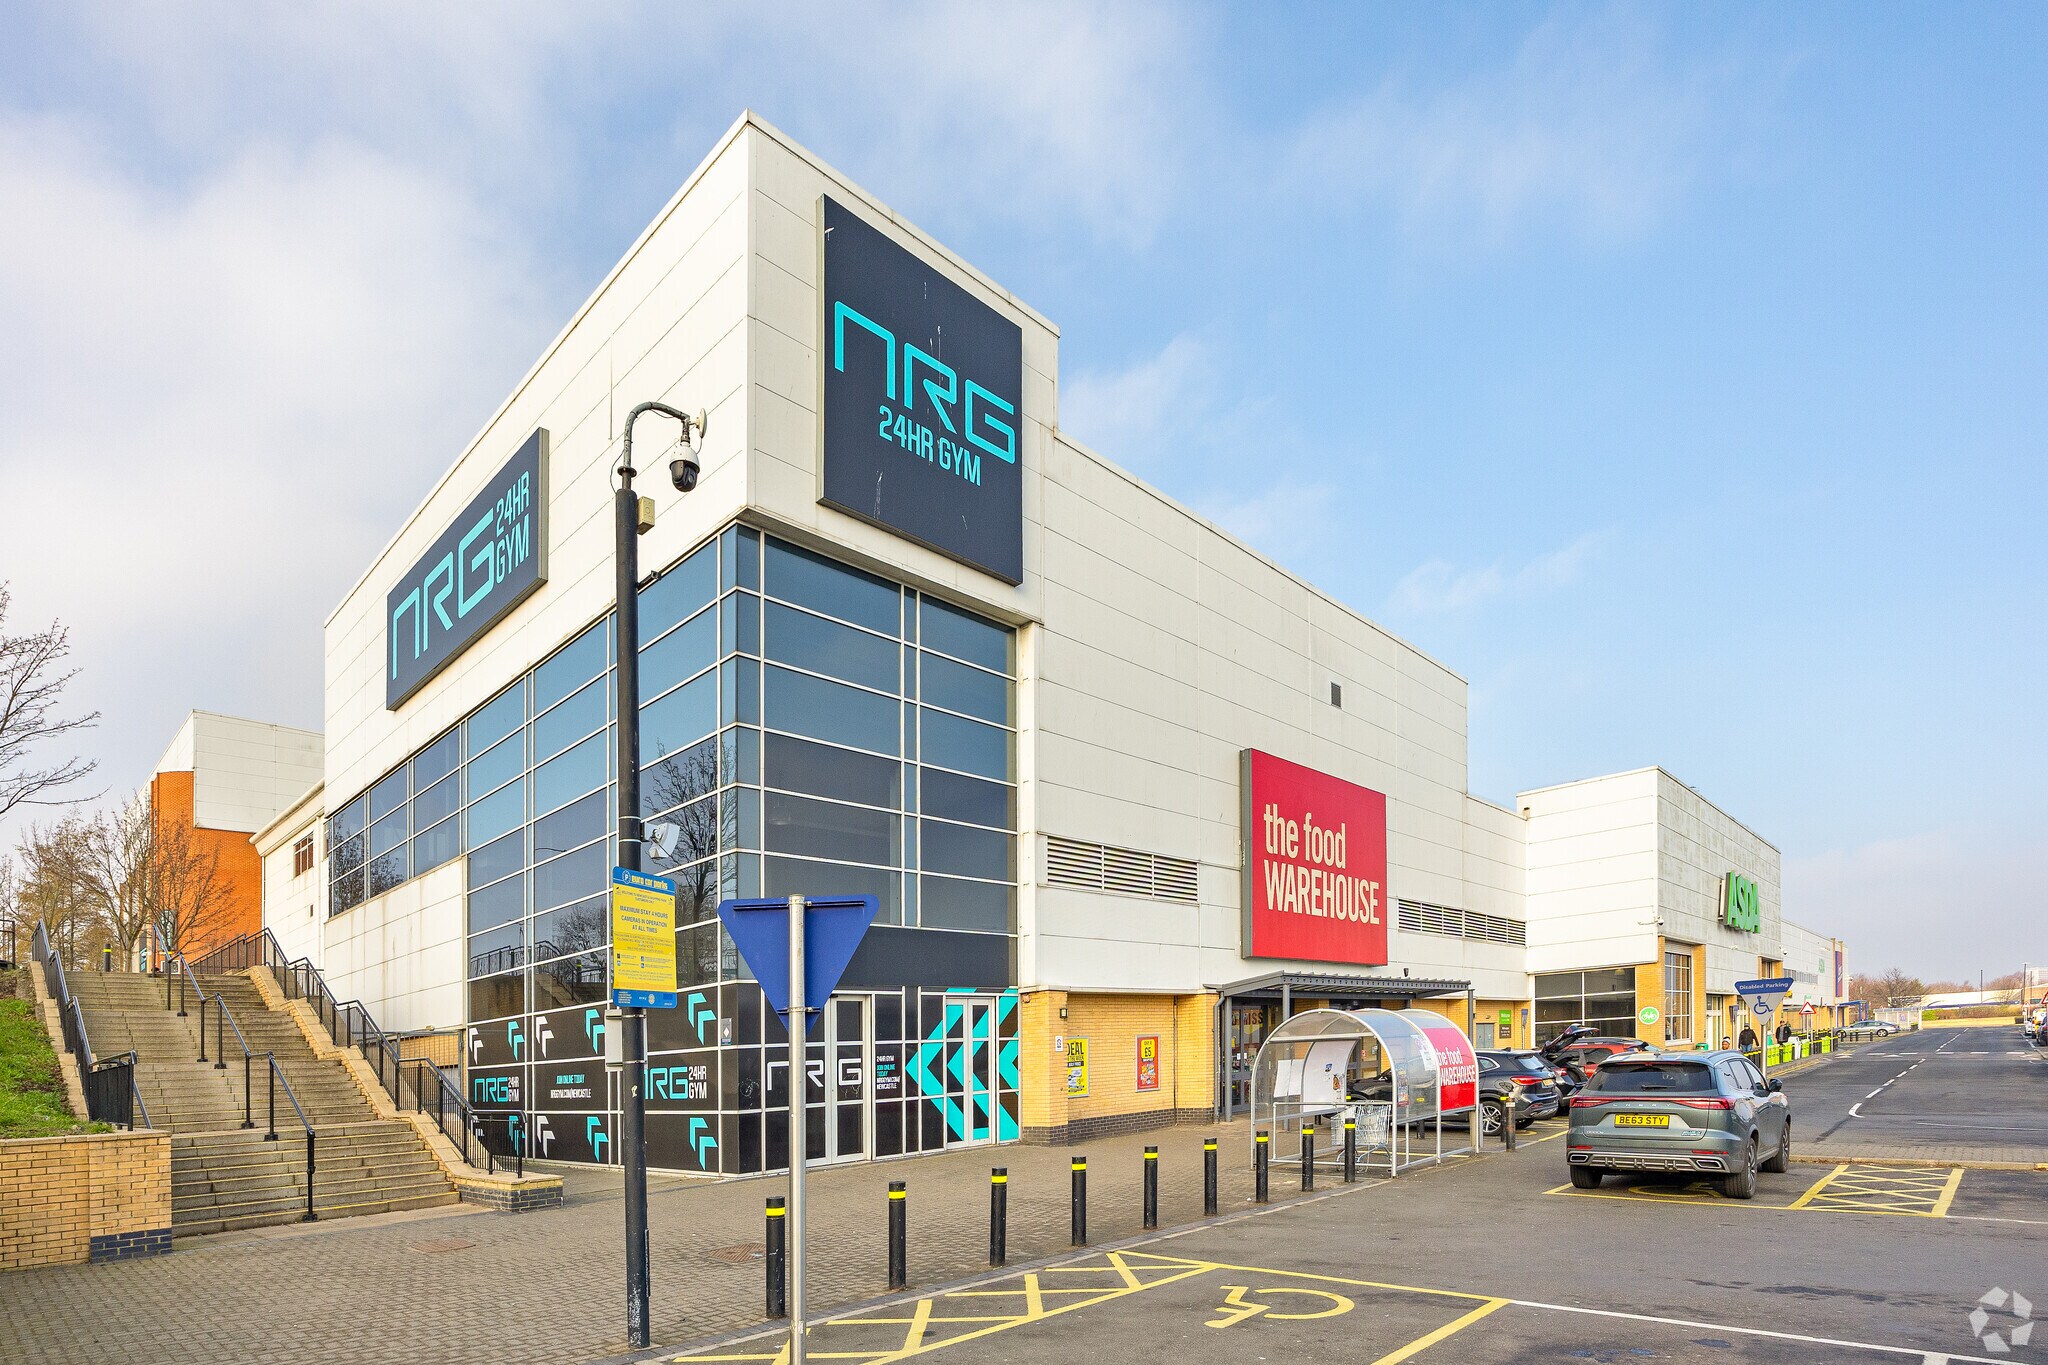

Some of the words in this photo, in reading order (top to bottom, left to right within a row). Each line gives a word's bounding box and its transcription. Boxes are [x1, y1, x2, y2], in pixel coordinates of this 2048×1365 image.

[834, 301, 1016, 464] NRG
[879, 405, 934, 463] 24HR
[939, 437, 981, 486] GYM
[496, 470, 530, 538] 24HR
[496, 513, 530, 584] GYM
[392, 507, 495, 681] NRG
[1263, 803, 1299, 859] the
[1303, 812, 1346, 869] food
[1264, 859, 1380, 925] WAREHOUSE
[1727, 870, 1760, 934] ASDA
[620, 906, 640, 914] MAXIMUM
[1145, 1047, 1152, 1057] £5
[1445, 1047, 1463, 1065] food
[508, 1076, 519, 1088] 24HR
[688, 1065, 707, 1080] 24HR
[1440, 1065, 1475, 1087] WAREHOUSE
[474, 1077, 508, 1102] NRG
[508, 1088, 519, 1102] GYM
[688, 1082, 707, 1099] GYM
[1619, 1116, 1643, 1125] BE63
[1645, 1116, 1664, 1125] STY
